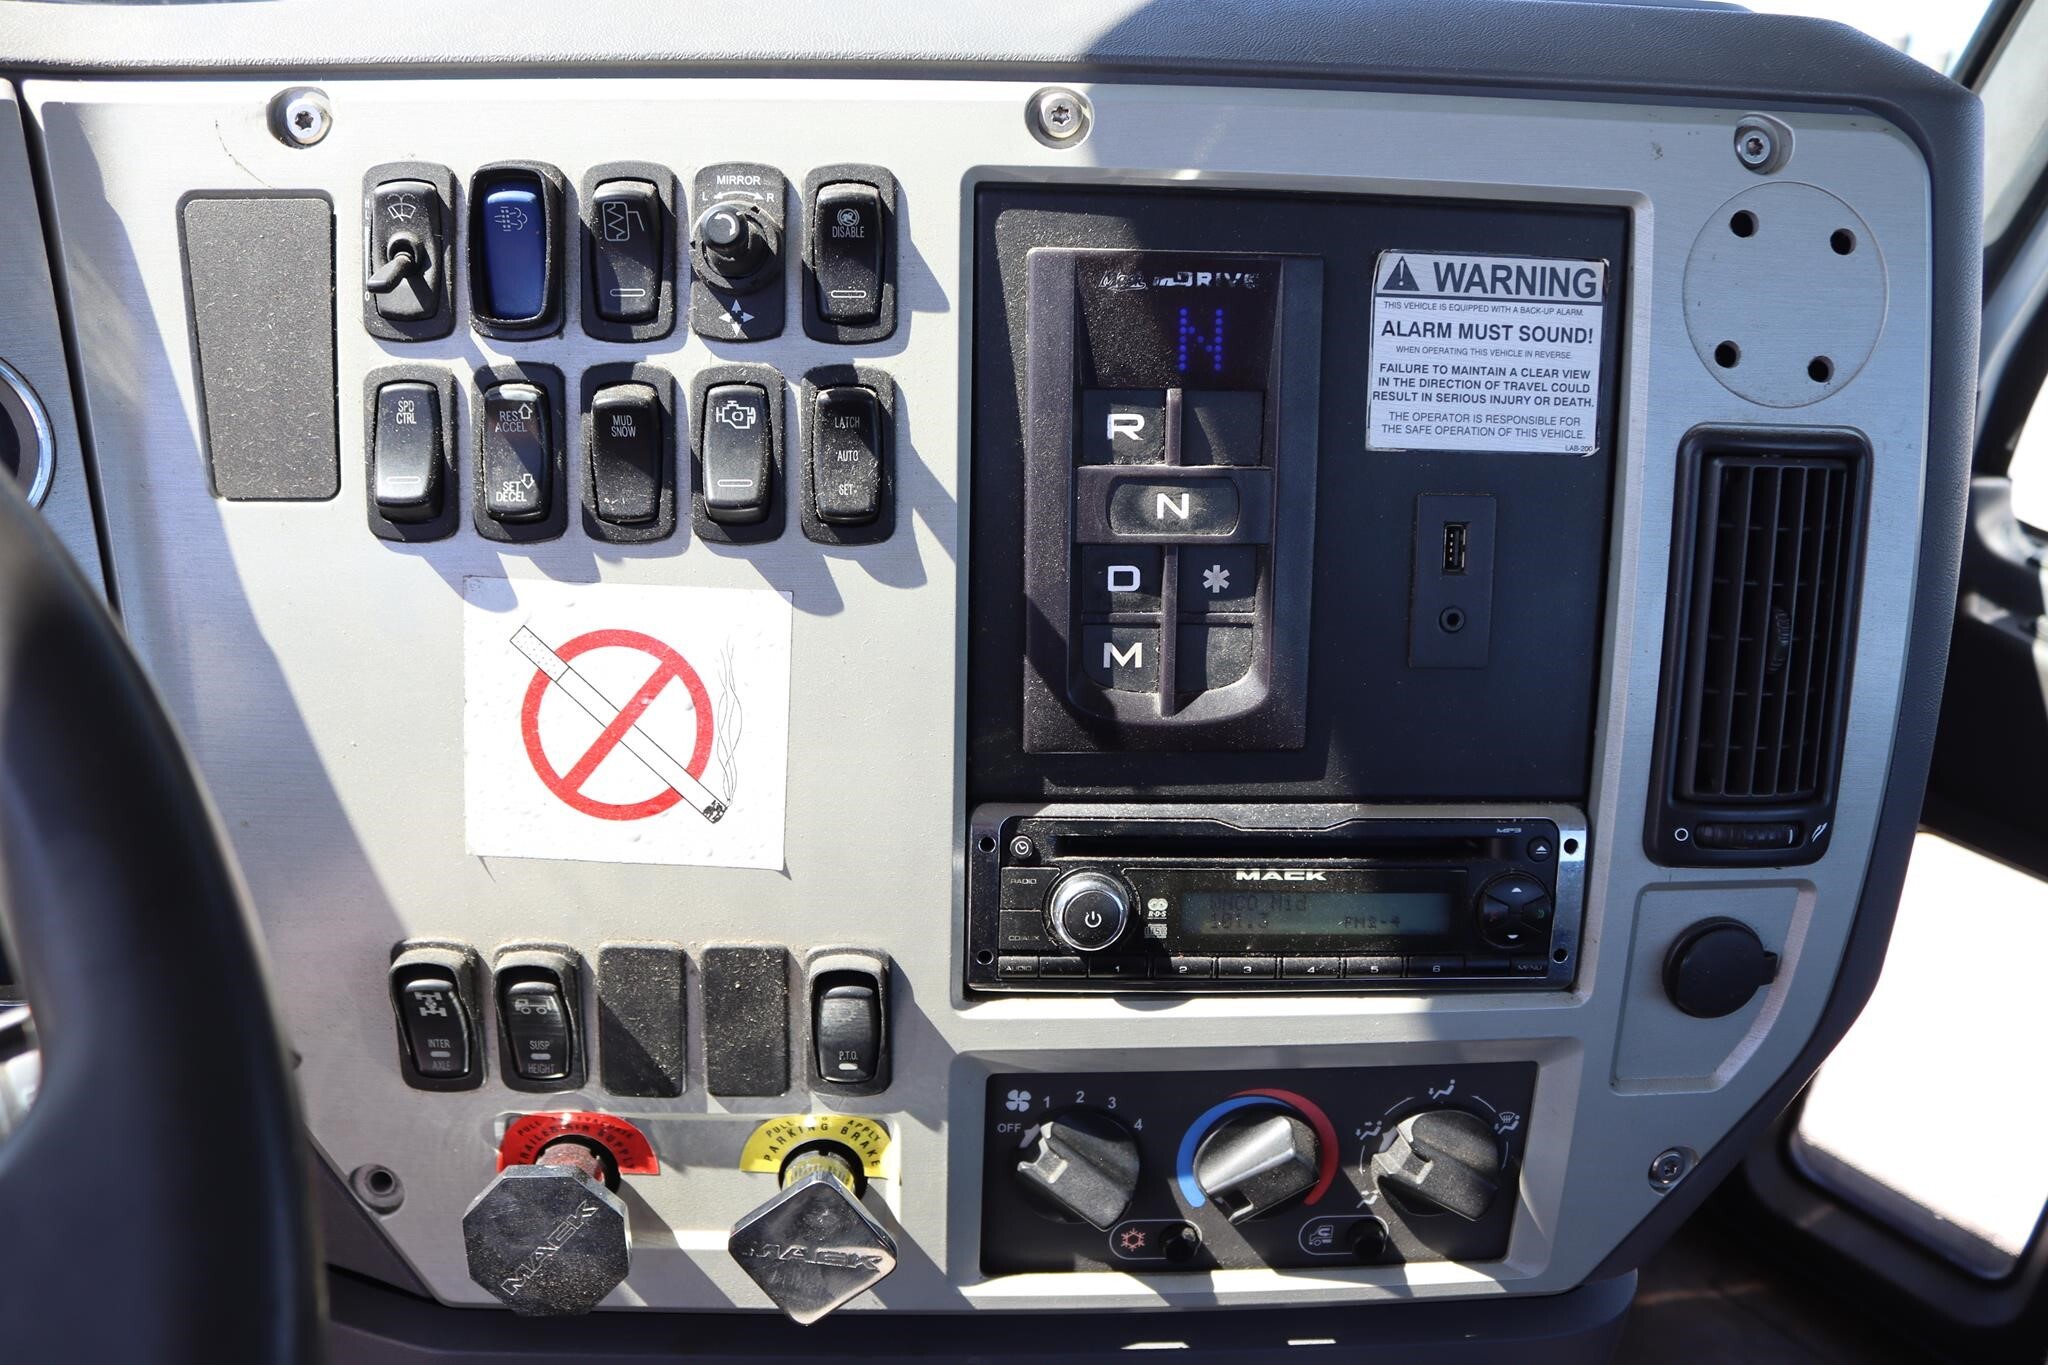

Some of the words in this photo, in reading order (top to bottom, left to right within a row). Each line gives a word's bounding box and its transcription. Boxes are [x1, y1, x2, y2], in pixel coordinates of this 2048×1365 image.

[716, 175, 761, 186] MIRROR
[702, 192, 708, 201] L
[766, 193, 775, 202] R
[832, 226, 865, 238] DISABLE
[1433, 262, 1597, 298] WARNING
[1384, 301, 1401, 310] THIS
[1404, 302, 1437, 310] VEHICLE
[1449, 304, 1489, 312] EQUIPPED
[1520, 306, 1555, 315] BACK-UP
[1381, 320, 1452, 338] ALARM
[1459, 323, 1514, 341] MUST
[1519, 325, 1593, 344] SOUND!
[1178, 307, 1224, 371] N
[1396, 346, 1420, 354] WHEN
[1422, 346, 1468, 356] OPERATING
[1470, 348, 1488, 356] THIS
[1490, 349, 1522, 358] VEHICLE
[1525, 350, 1533, 358] IN
[1380, 363, 1429, 374] FAILURE
[1432, 364, 1448, 374] TO
[1451, 366, 1506, 376] MAINTAIN
[1510, 368, 1518, 376] A
[1520, 368, 1559, 378] CLEAR
[1562, 370, 1591, 380] VIEW
[1378, 377, 1390, 386] IN
[1392, 378, 1416, 388] THE
[1420, 378, 1481, 390] DIRECTION
[1484, 380, 1500, 390] OF
[1504, 381, 1548, 392] TRAVEL
[1551, 382, 1590, 394] COULD
[1372, 391, 1418, 401] RESULT
[1422, 392, 1432, 402] IN
[1436, 393, 1486, 404] SERIOUS
[1490, 395, 1531, 405] INJURY
[1534, 396, 1550, 406] OR
[1554, 397, 1594, 408] DEATH.
[398, 400, 414, 412] SPD
[396, 412, 417, 424] CTRL
[612, 414, 632, 426] MUD
[834, 416, 860, 428] LATCH
[1388, 412, 1410, 422] THE
[1412, 412, 1470, 423] OPERATOR
[1473, 414, 1482, 424] IS
[1486, 414, 1557, 426] RESPONSIBLE
[1560, 417, 1581, 426] FOR
[495, 422, 528, 432] ACCEL
[611, 426, 636, 437] SNOW
[1106, 413, 1145, 440] R
[1382, 424, 1402, 434] THE
[1405, 424, 1432, 434] SAFE
[1434, 426, 1496, 436] OPERATION
[1498, 427, 1512, 437] OF
[1515, 428, 1538, 438] THIS
[1540, 429, 1585, 440] VEHICLE.
[838, 450, 859, 462] AUTO
[502, 481, 521, 492] SET
[496, 492, 527, 502] DECEL
[1156, 493, 1190, 520] N
[1107, 565, 1141, 592] D
[1103, 642, 1143, 668] M
[1236, 871, 1327, 881] MACK
[1178, 966, 1188, 974] 2
[428, 1039, 450, 1048] INTER
[529, 1040, 550, 1050] SUSP
[432, 1061, 450, 1071] AXLE
[528, 1064, 555, 1074] HEIGHT
[1044, 1096, 1050, 1108] 1
[1076, 1090, 1085, 1103] 2
[1108, 1096, 1117, 1109] 3
[997, 1123, 1022, 1133] OFF
[1134, 1118, 1143, 1131] 4
[766, 1120, 794, 1138] PULL
[847, 1120, 881, 1142] APPLY
[598, 1129, 636, 1169] SUPPLY
[840, 1126, 881, 1166] BRAKE
[501, 1200, 600, 1296] MACK
